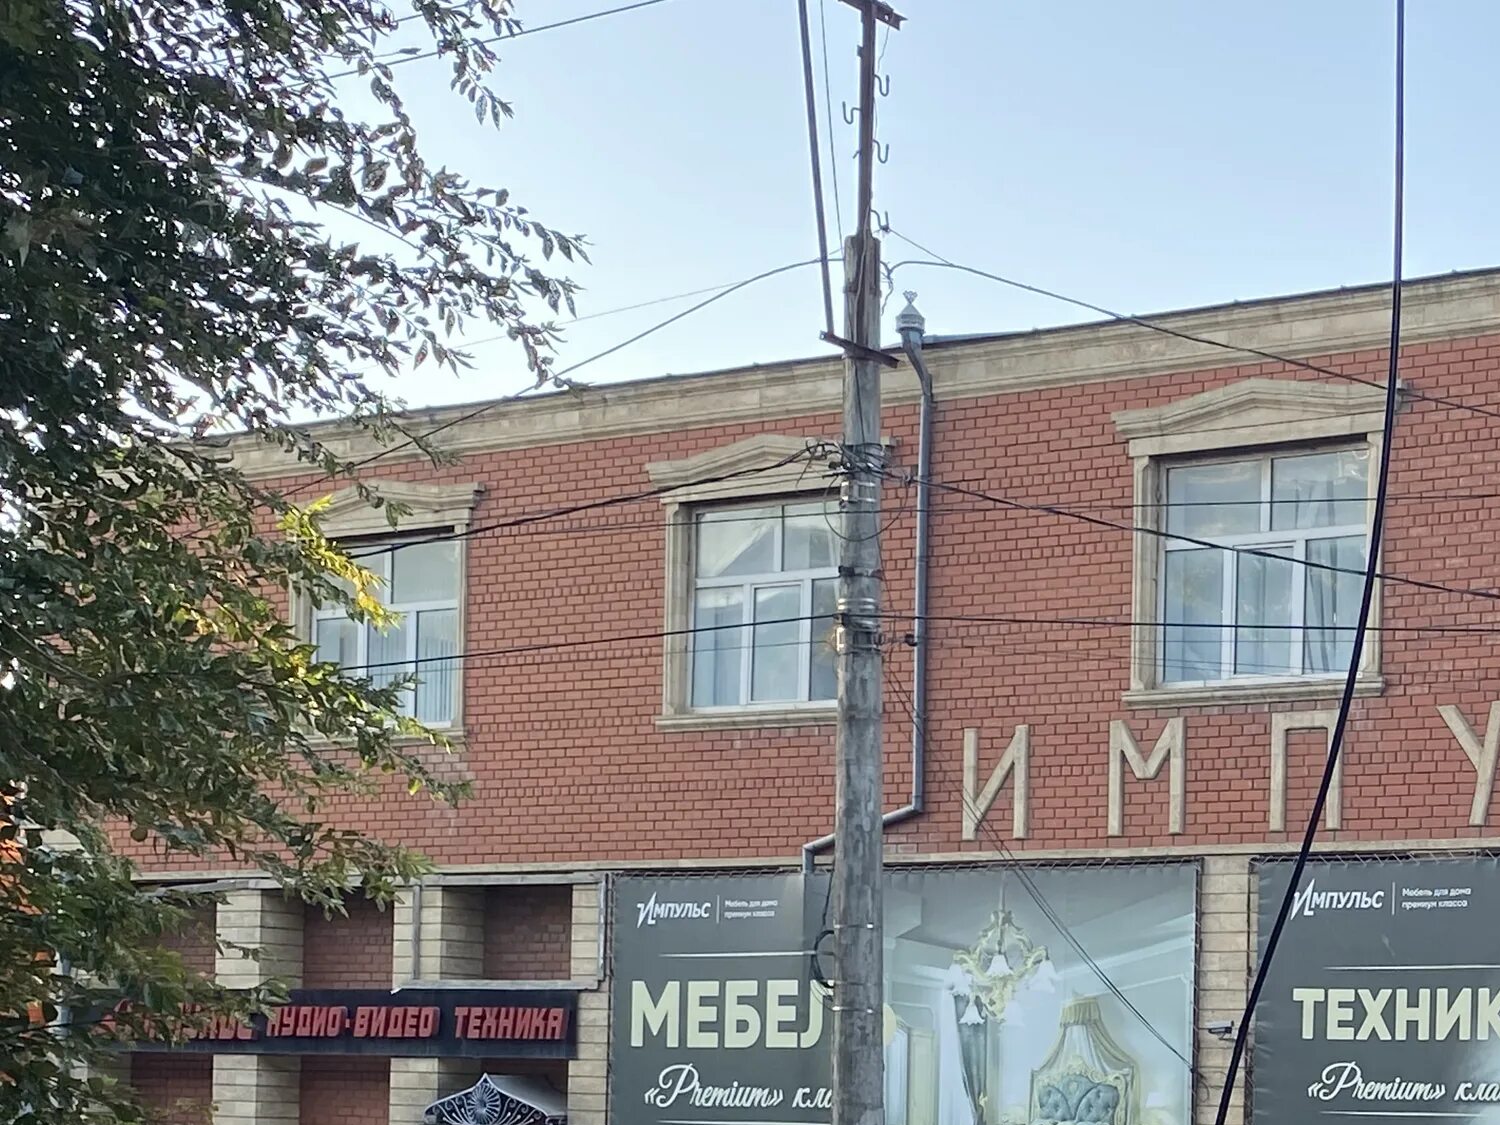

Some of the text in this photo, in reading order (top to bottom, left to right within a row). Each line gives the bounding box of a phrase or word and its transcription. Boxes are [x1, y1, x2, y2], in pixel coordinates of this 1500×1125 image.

[636, 891, 711, 928] ИМПУЛЬС
[1290, 878, 1385, 920] ИМПУЛЬС
[454, 1006, 567, 1039] ТЕХНИКА
[630, 980, 896, 1049] МЕБЕЛ
